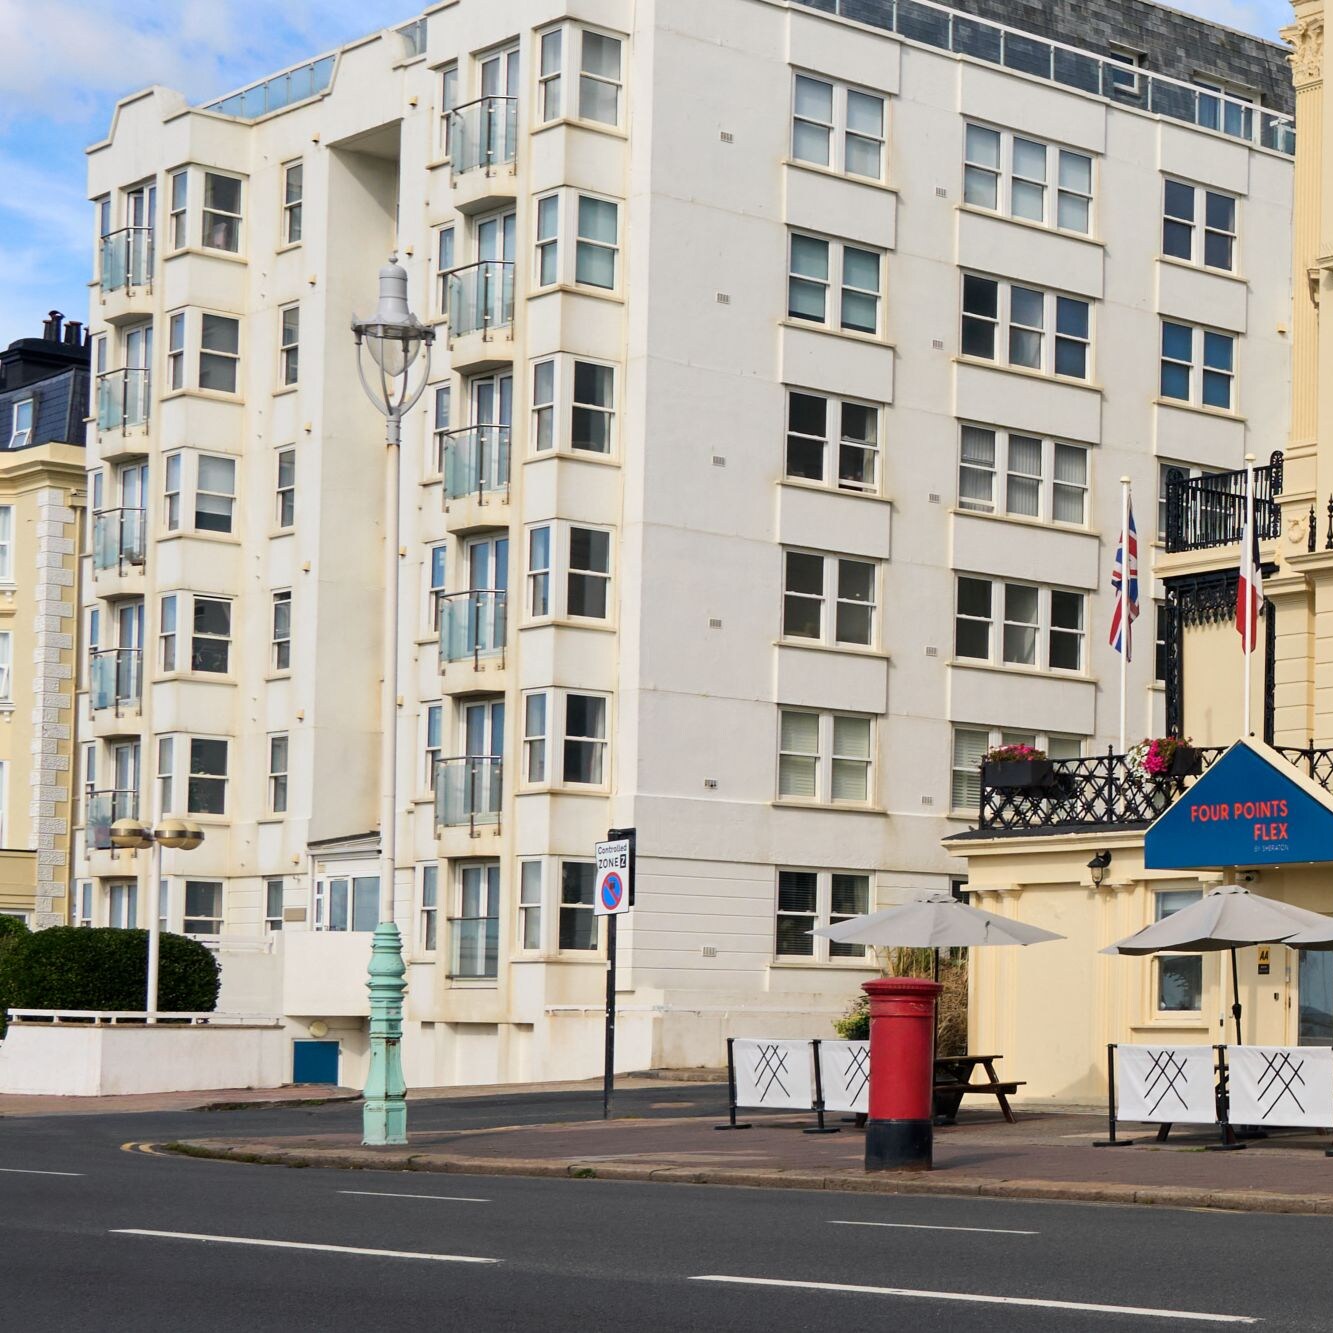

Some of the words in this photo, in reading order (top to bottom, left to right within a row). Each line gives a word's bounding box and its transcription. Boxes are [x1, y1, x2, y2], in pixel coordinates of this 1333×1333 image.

[1191, 804, 1229, 822] FOUR
[1234, 800, 1288, 819] POINTS
[1254, 823, 1288, 840] FLEX
[598, 843, 627, 854] Controlled
[598, 857, 619, 869] ZONE
[1260, 950, 1269, 960] AA
